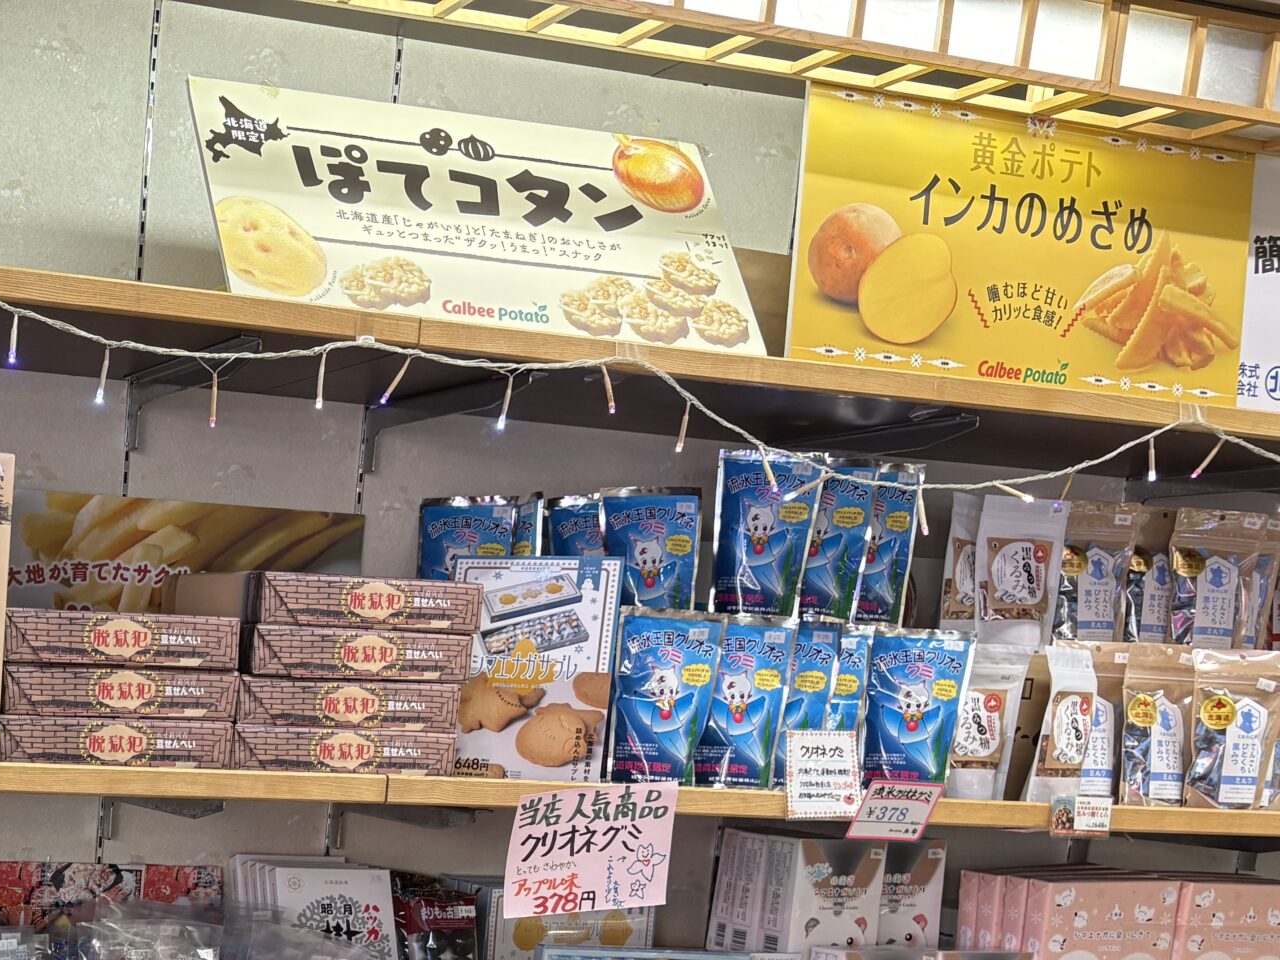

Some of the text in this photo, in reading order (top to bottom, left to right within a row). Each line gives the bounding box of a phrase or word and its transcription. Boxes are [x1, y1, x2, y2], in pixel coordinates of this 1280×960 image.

[224, 117, 267, 133] 北海道
[969, 131, 1102, 188] 黄金ポテト
[292, 145, 643, 232] ぽてコタン
[909, 174, 1153, 255] インカのめざめ
[987, 282, 1069, 310] 噛むほど甘い
[442, 300, 549, 324] Calbee Potato
[992, 305, 1063, 330] カリッと食感!
[978, 360, 1067, 386] Calbee Potato
[427, 511, 511, 540] 流氷王国クリオネ
[609, 505, 695, 540] 流氷王国クリオネ
[639, 520, 665, 536] グミ
[471, 652, 578, 681] シマエナガサブレ
[659, 648, 683, 664] グミ
[728, 654, 756, 668] グミ
[1207, 713, 1230, 722] 北海道
[454, 756, 489, 771] 648円
[1088, 770, 1106, 778] ミルク
[1162, 773, 1179, 781] ミルク
[1235, 776, 1253, 784] ミルク
[519, 786, 668, 828] 当店人気商品
[866, 806, 909, 822] ¥378
[520, 824, 642, 862] クリオネグミ
[512, 872, 581, 897] アップル味
[321, 903, 353, 915] 昭月
[533, 890, 596, 915] 378円
[363, 903, 381, 943] ハッカ
